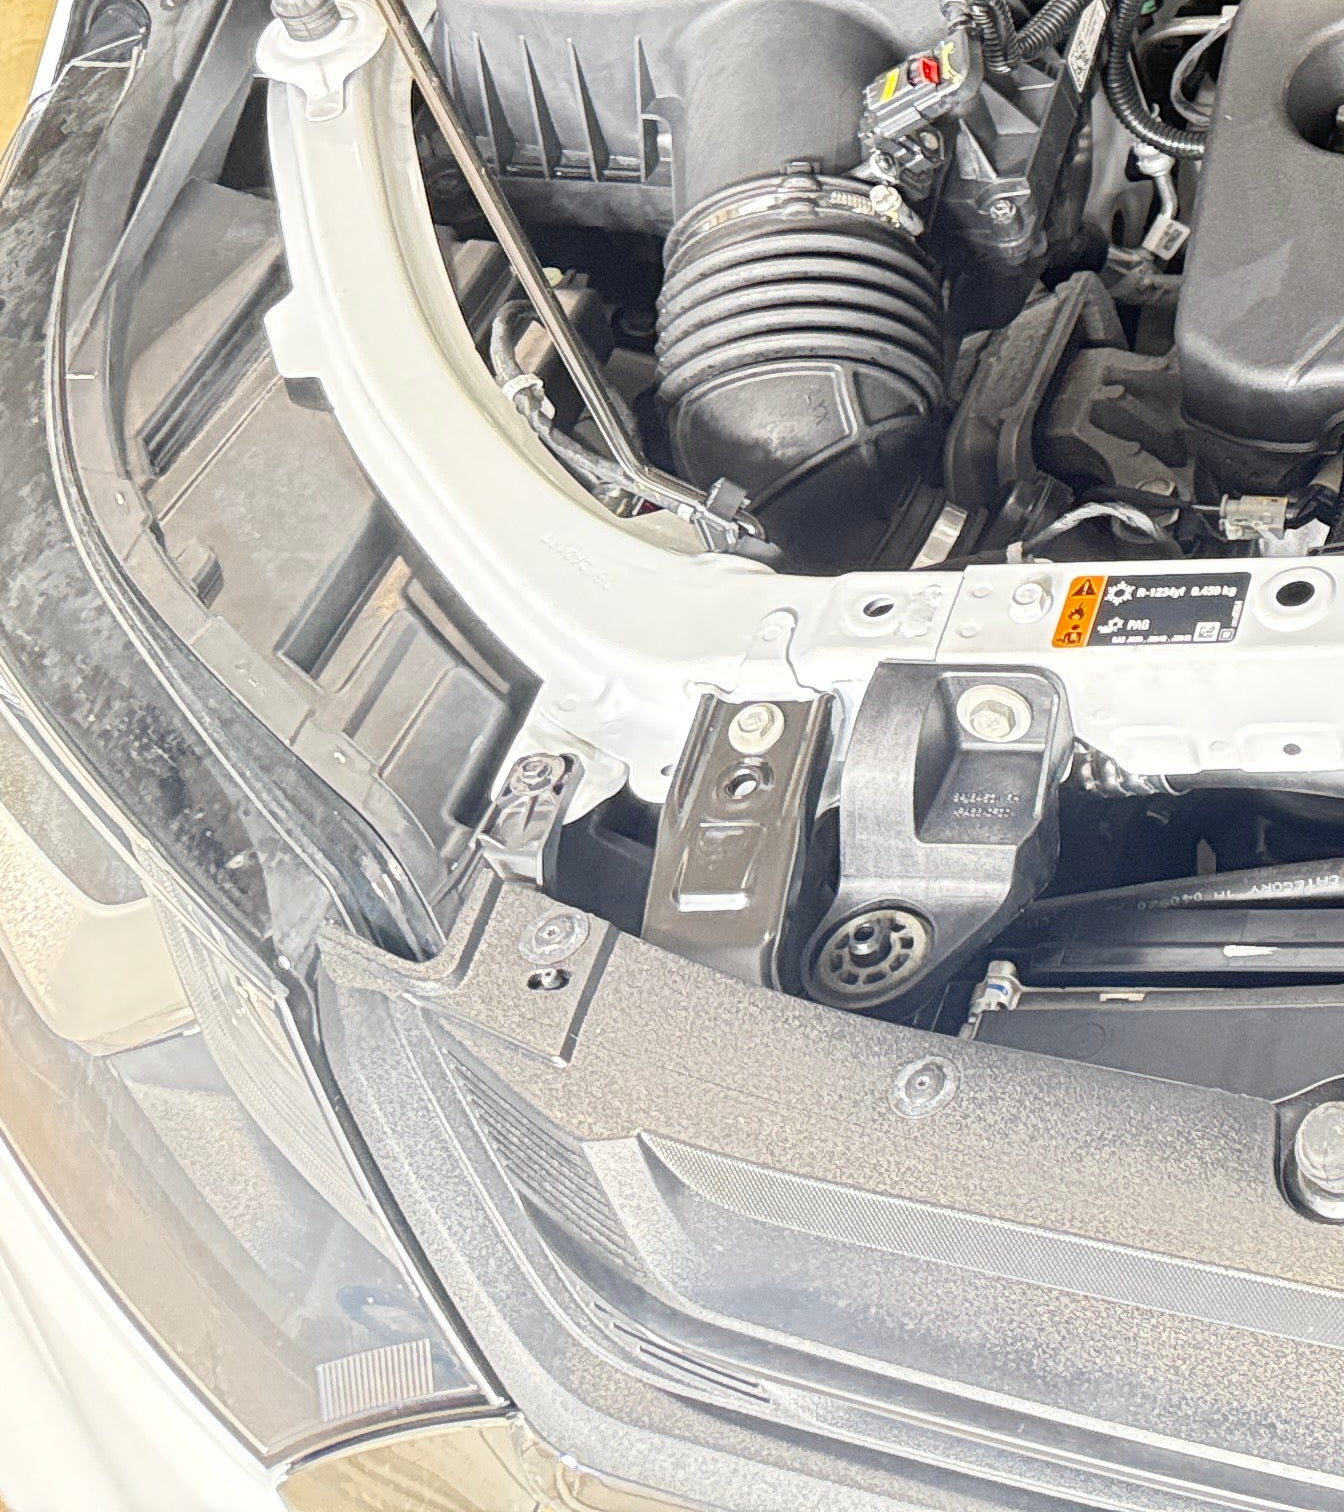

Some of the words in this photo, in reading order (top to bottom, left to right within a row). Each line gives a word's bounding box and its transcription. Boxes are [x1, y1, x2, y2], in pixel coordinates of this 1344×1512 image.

[1136, 586, 1186, 599] R-1234yf
[1221, 585, 1238, 598] kg
[1126, 619, 1151, 631] PAG
